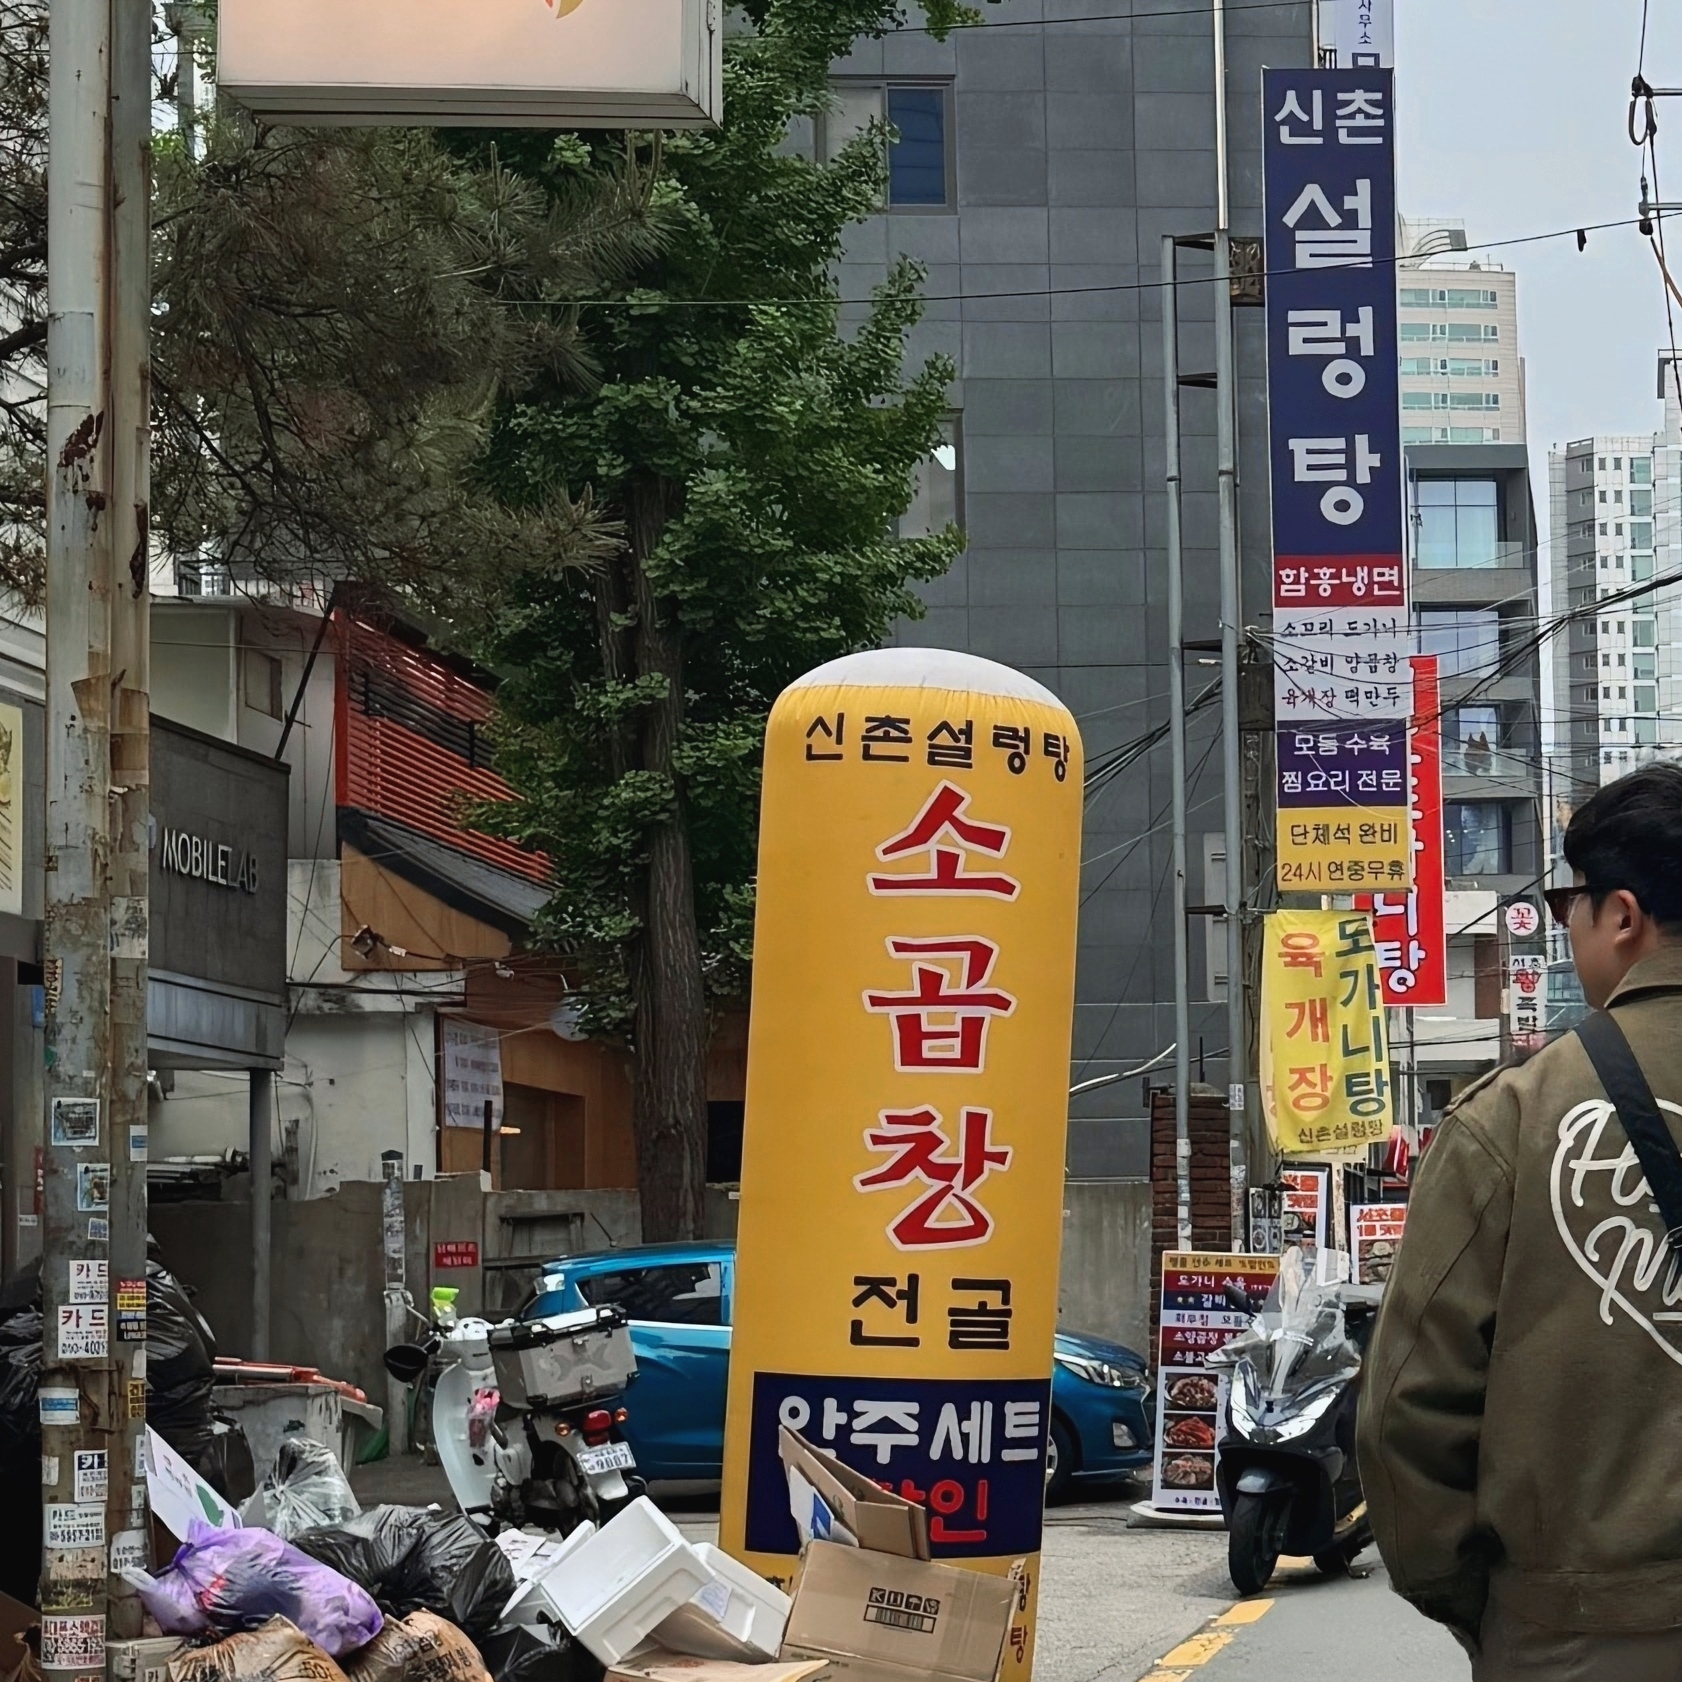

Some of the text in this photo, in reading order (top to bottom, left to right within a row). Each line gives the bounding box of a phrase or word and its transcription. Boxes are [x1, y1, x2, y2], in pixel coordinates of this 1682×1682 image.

[1274, 89, 1385, 144] 신촌
[1282, 178, 1381, 525] 설렁탕
[1278, 565, 1400, 597] 함흥냉면
[806, 713, 1070, 782] 신촌설렁탕
[1281, 770, 1403, 792] 찜요리 전문
[1291, 822, 1398, 845] 단체석 완비
[1281, 859, 1406, 882] 24시 연중무휴
[853, 779, 1021, 1251] 소곱창
[1278, 933, 1334, 1112] 육개장
[1336, 917, 1389, 1117] 도가니탕
[850, 1273, 1013, 1350] 전골
[778, 1396, 1040, 1465] 안주세트
